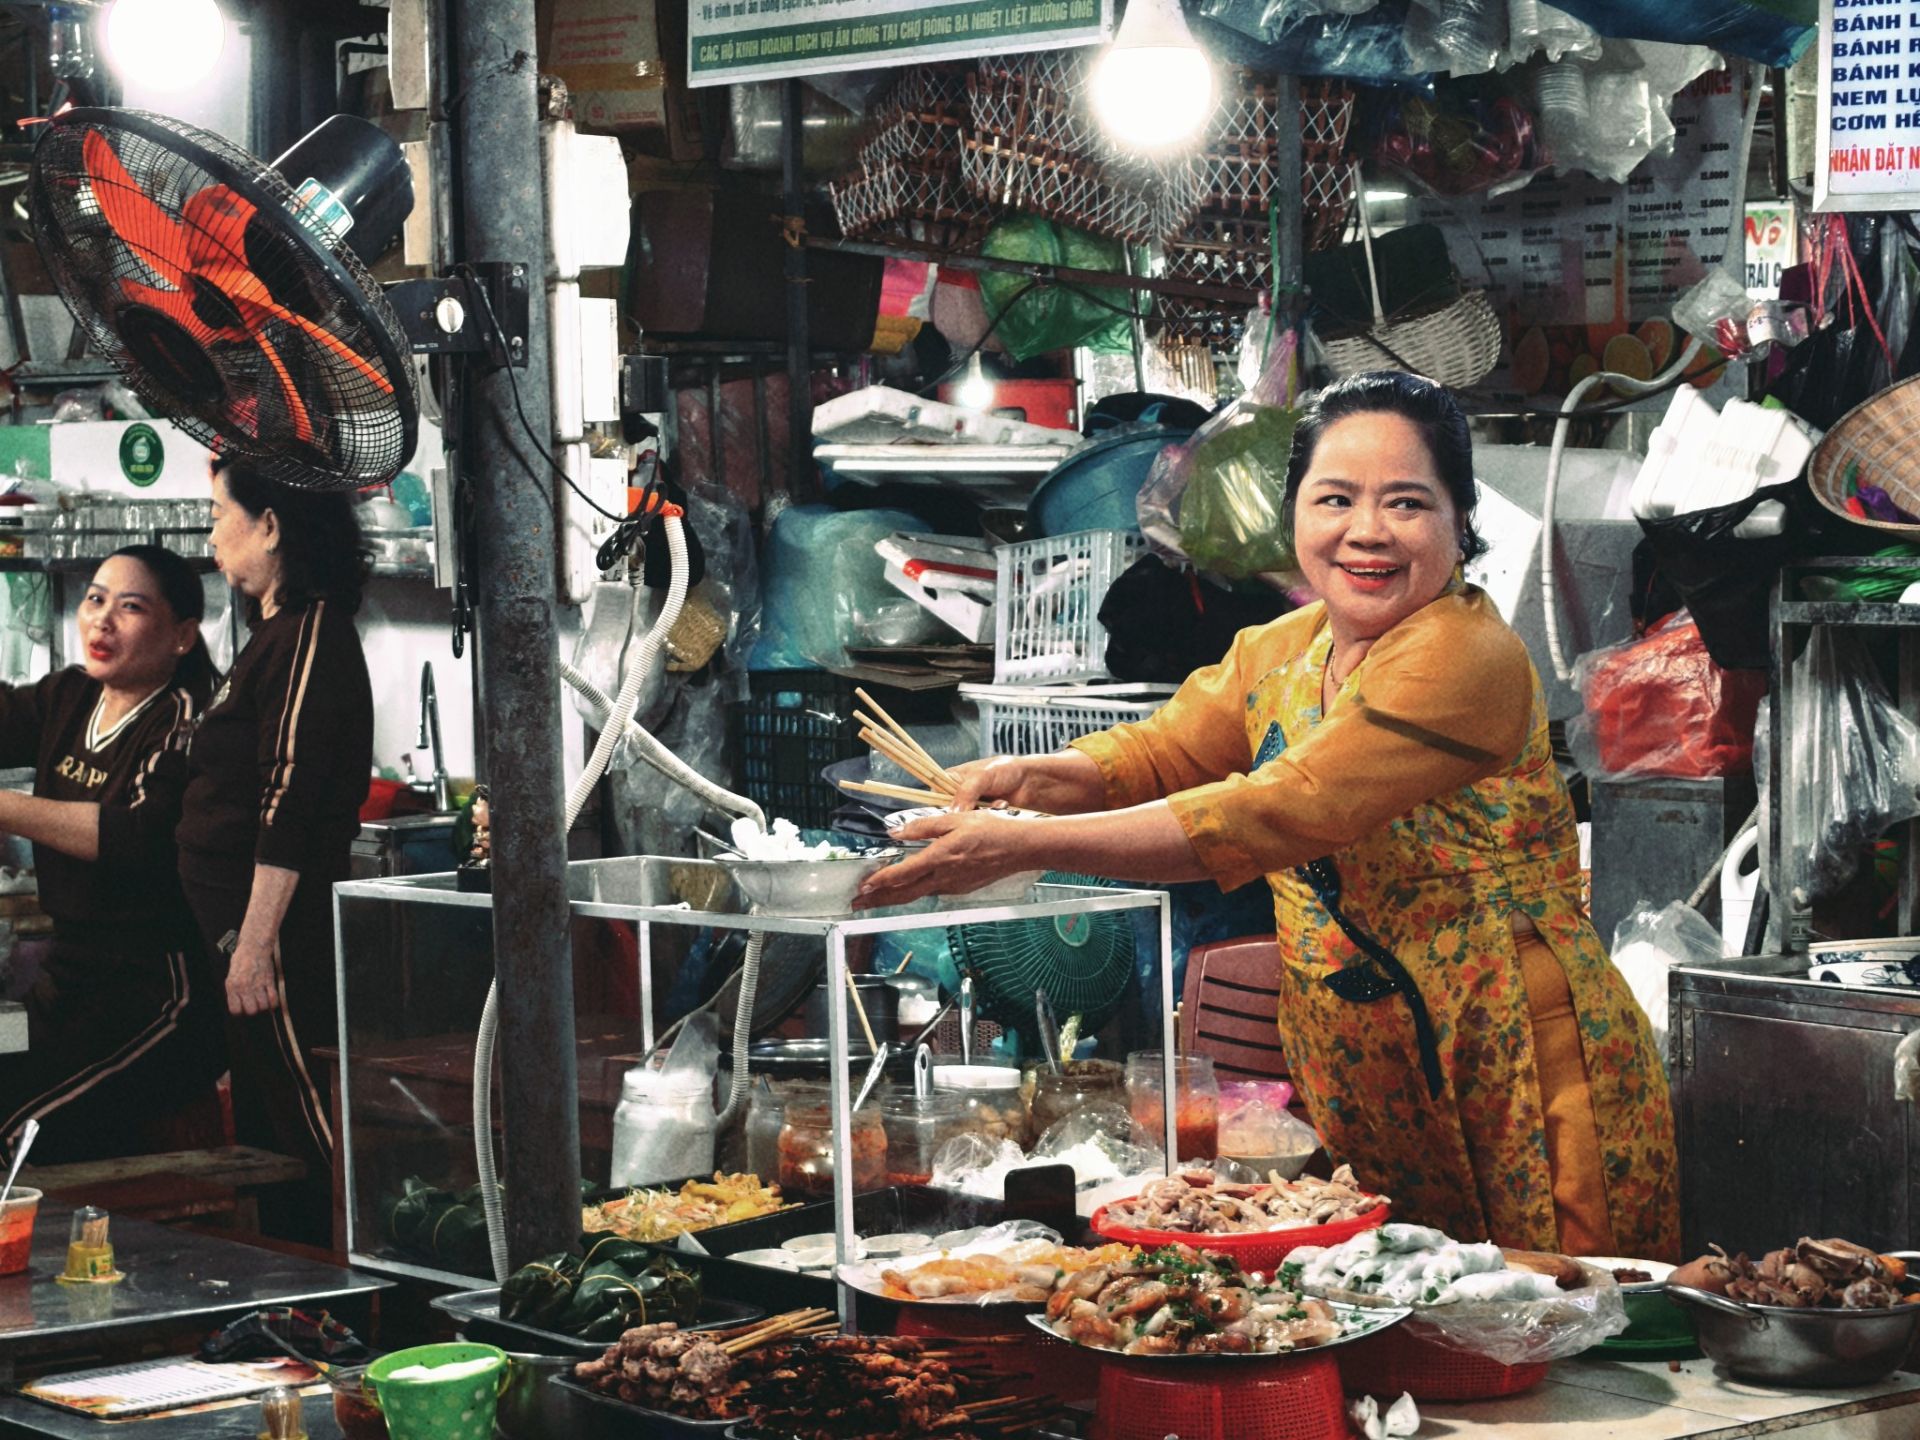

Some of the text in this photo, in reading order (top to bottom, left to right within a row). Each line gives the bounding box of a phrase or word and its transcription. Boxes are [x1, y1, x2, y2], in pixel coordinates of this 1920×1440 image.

[1833, 13, 1901, 32] BÁNH
[700, 42, 719, 63] CÁC
[720, 39, 734, 63] HỘ
[736, 40, 759, 58] KINH
[760, 35, 793, 56] DOANH
[795, 32, 819, 54] DỊCH
[820, 30, 833, 52] VỤ
[835, 26, 850, 47] ĂN
[852, 22, 880, 45] UỐNG
[881, 23, 898, 45] TẠI
[900, 18, 921, 41] CHỢ
[923, 15, 953, 36] ĐÔNG
[954, 13, 969, 33] BA
[971, 8, 1002, 32] NHIỆT
[1004, 4, 1028, 28] LIỆT
[1832, 38, 1900, 57] BÁNH
[1832, 63, 1899, 81] BÁNH
[1832, 89, 1887, 106] NEM
[1832, 114, 1886, 131] CƠM
[1831, 144, 1870, 177] NHẬN
[1876, 142, 1904, 175] ĐẶT
